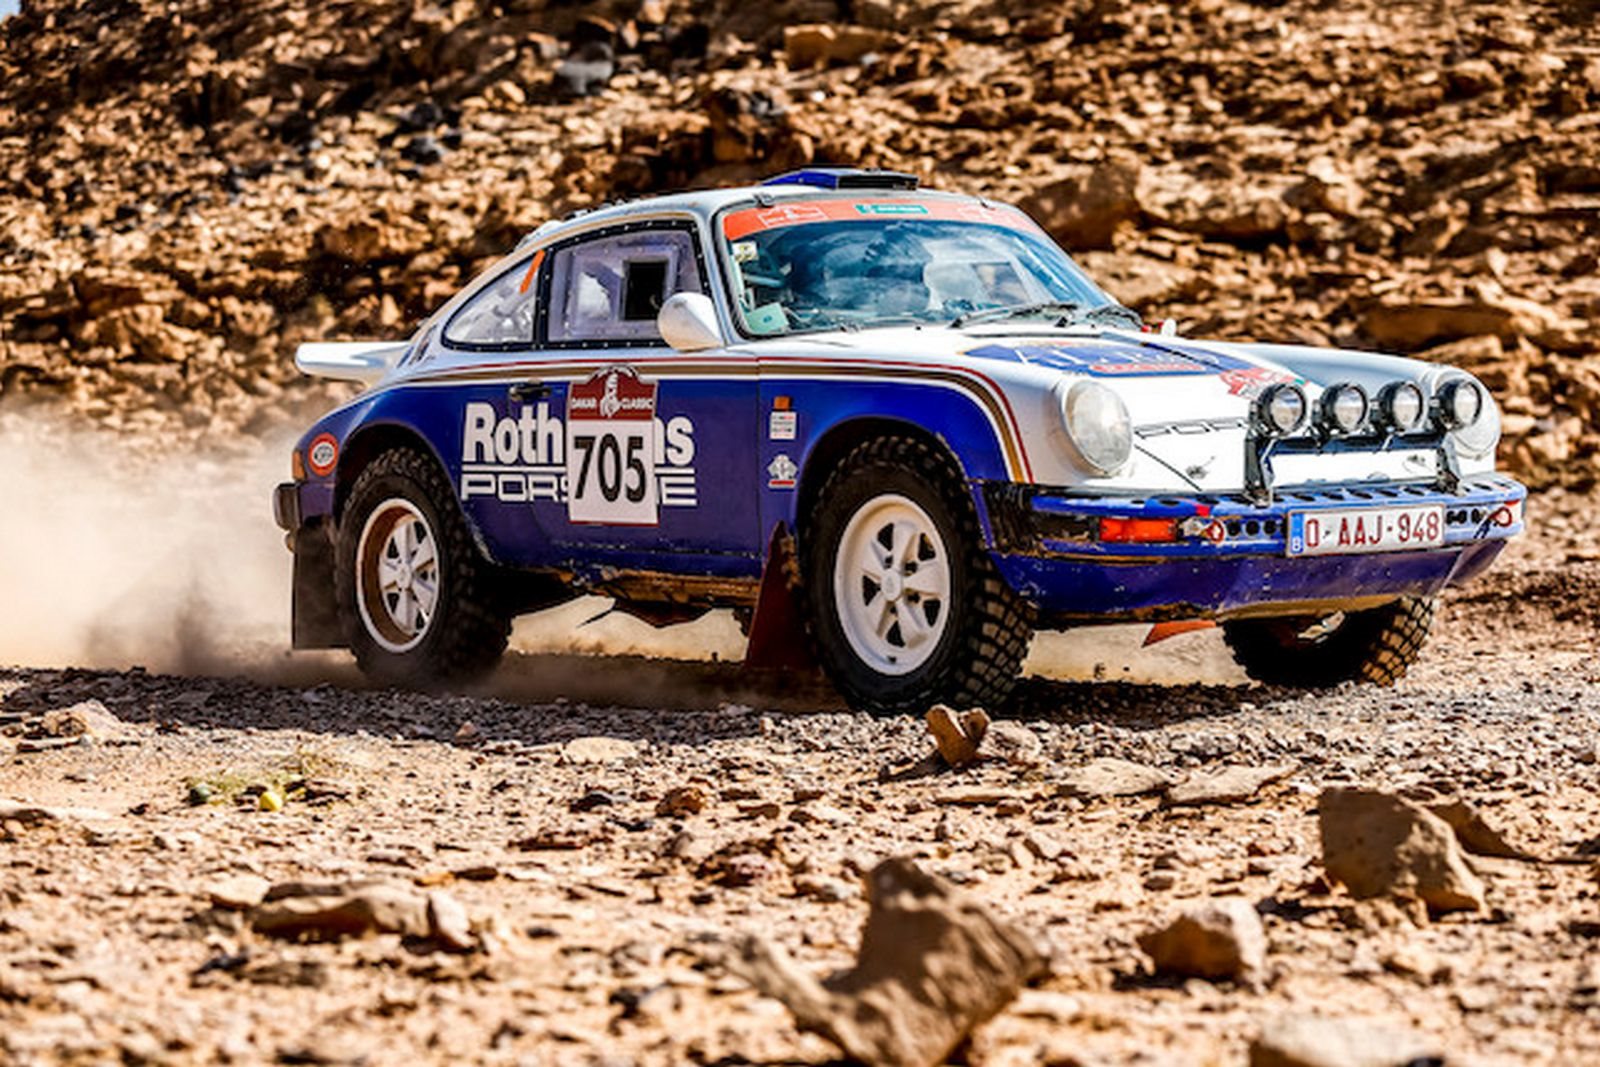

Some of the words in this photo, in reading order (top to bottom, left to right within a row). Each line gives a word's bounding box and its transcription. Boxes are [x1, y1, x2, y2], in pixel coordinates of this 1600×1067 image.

[461, 402, 695, 466] Roths
[460, 473, 697, 505] PORE
[574, 433, 647, 503] 705
